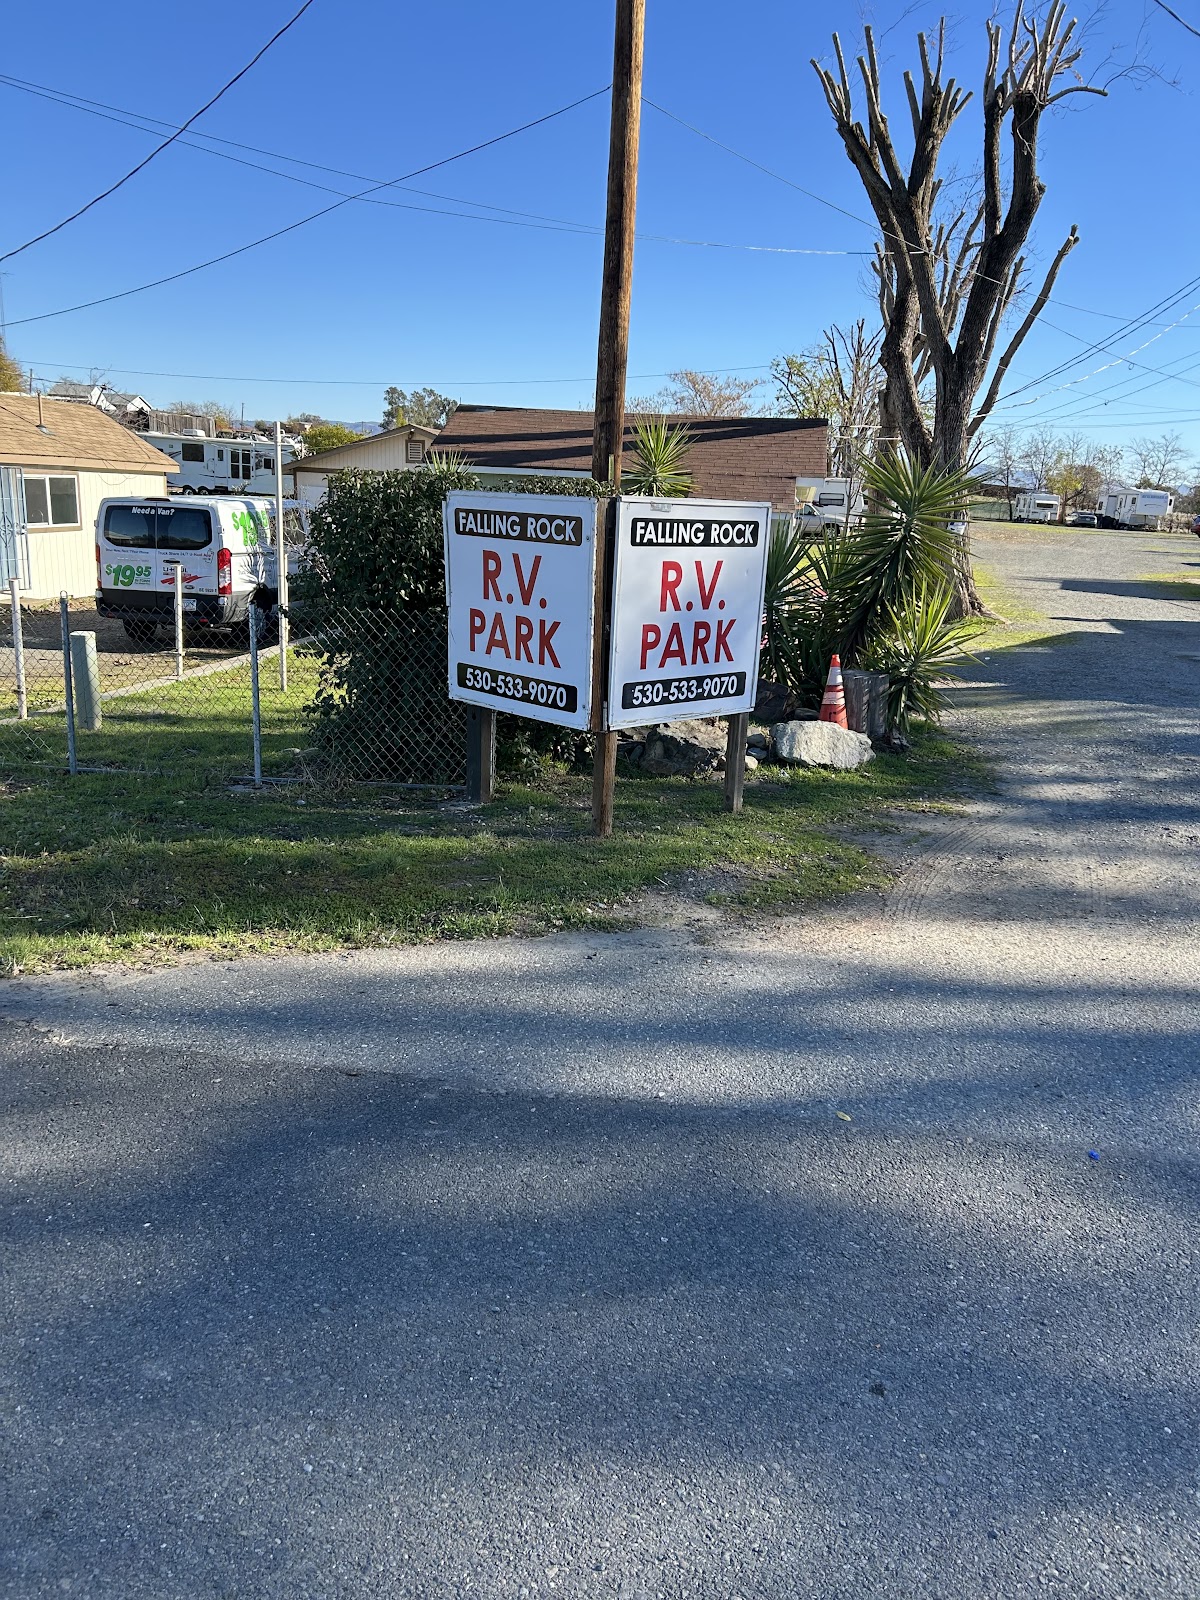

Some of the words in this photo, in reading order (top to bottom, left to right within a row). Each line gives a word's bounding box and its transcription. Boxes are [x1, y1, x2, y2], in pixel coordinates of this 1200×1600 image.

[458, 511, 521, 537] FALLING
[527, 517, 577, 542] ROCK
[635, 521, 705, 544] FALLING
[710, 523, 755, 544] ROCK
[482, 549, 548, 609] R.V.
[659, 560, 727, 612] R.V.
[469, 608, 562, 669] PARK
[640, 618, 736, 670] PARK
[465, 667, 567, 708] 530-533-9070
[632, 674, 738, 706] 530-533-9070
